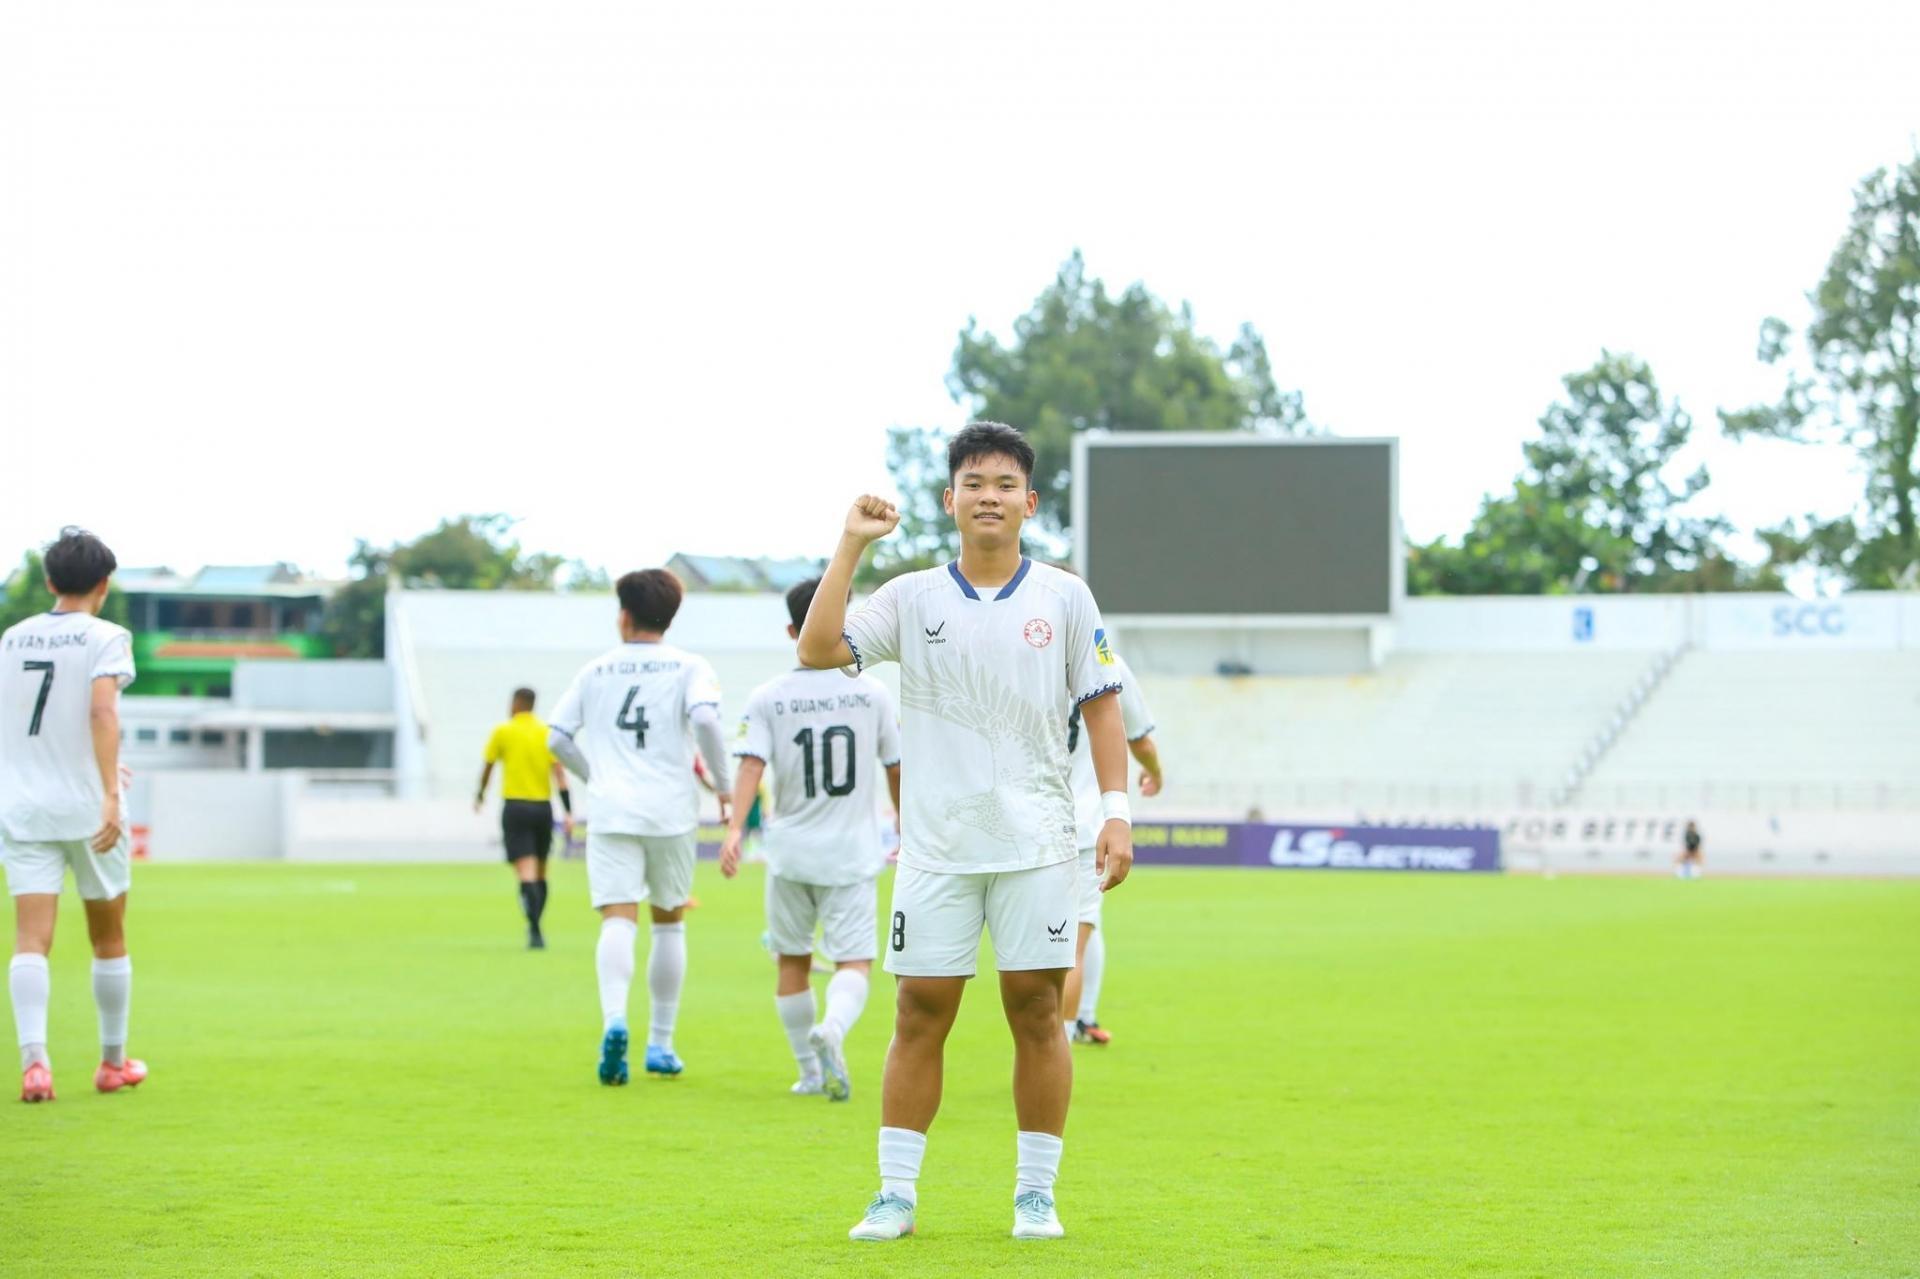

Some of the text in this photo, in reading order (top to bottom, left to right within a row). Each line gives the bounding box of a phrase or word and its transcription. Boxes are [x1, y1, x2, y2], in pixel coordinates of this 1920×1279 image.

[1771, 604, 1846, 636] SCG
[22, 660, 55, 736] 7
[616, 685, 649, 750] 4
[789, 697, 835, 715] QUANG
[792, 724, 857, 800] 10
[1269, 828, 1476, 870] LS ELECTRIC
[1503, 816, 1568, 843] FOR
[1581, 816, 1697, 843] BETTE
[892, 910, 906, 952] 8
